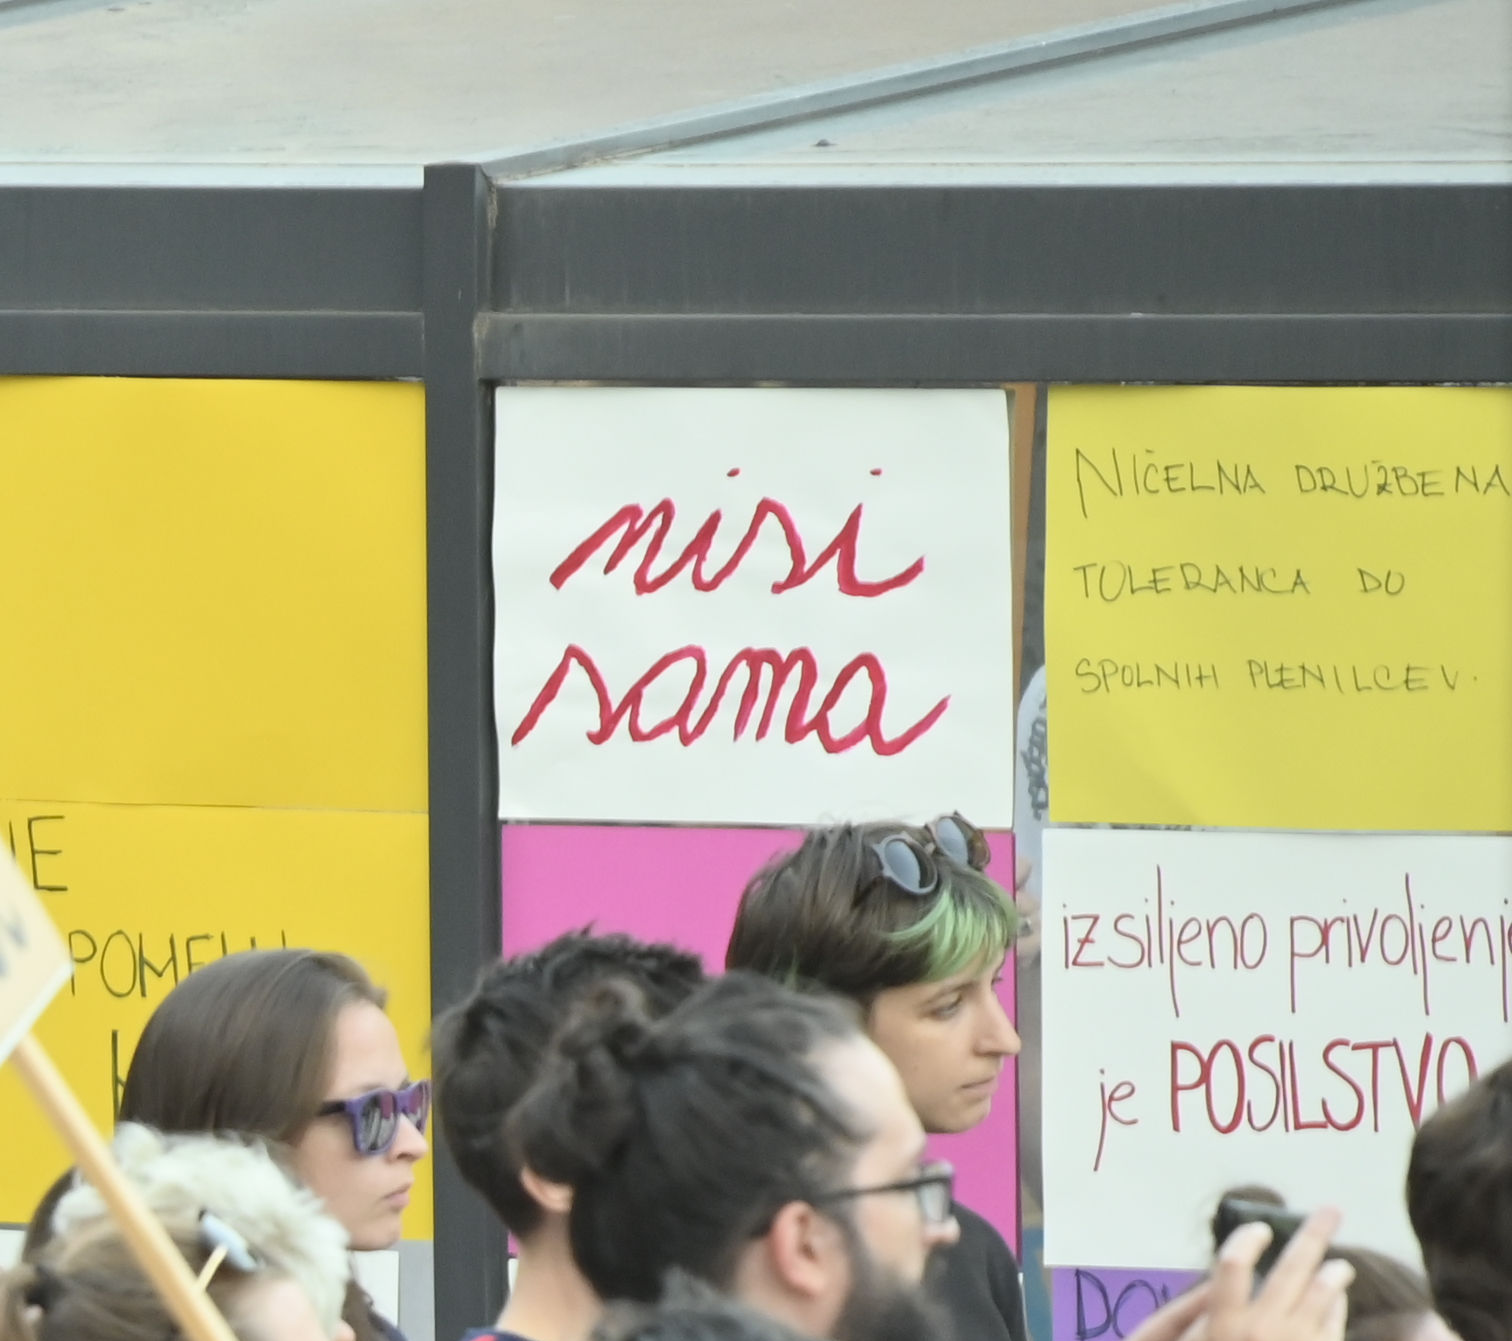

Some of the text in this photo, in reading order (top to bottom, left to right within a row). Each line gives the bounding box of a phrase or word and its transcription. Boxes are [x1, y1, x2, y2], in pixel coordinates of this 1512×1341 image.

[549, 467, 924, 598] nisi
[1075, 447, 1266, 519] NIČELNA
[511, 644, 952, 756] sama
[1074, 658, 1219, 694] SPOLNIH
[1062, 864, 1512, 1023] izsiljeno privoljenj
[1093, 1032, 1480, 1173] je POSILSTVO
